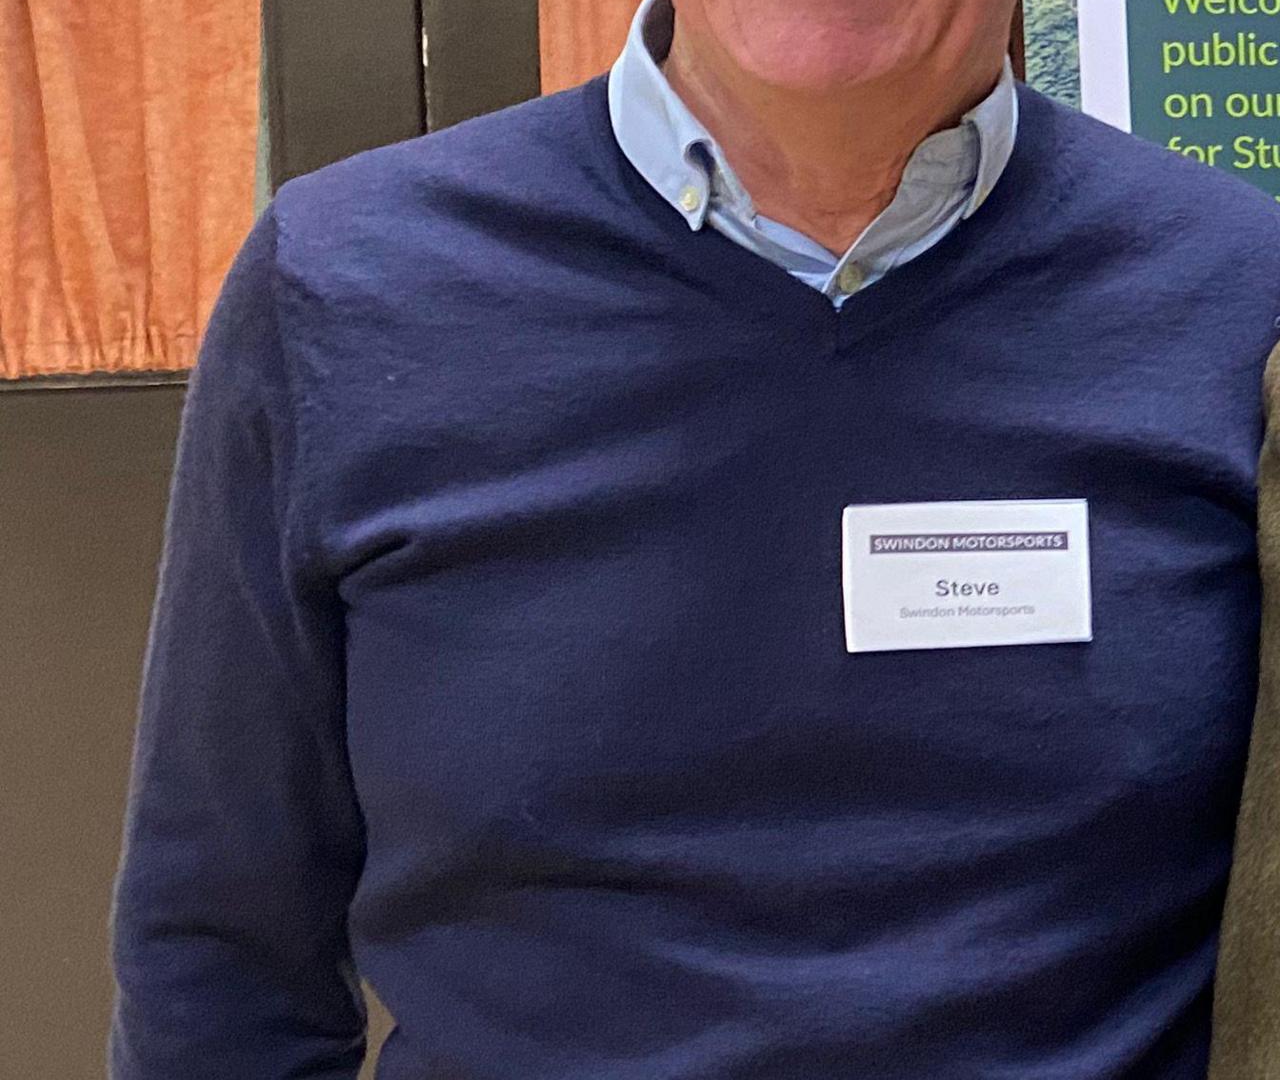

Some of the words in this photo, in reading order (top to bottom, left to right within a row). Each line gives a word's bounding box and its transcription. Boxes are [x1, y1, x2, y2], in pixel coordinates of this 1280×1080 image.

[1162, 32, 1279, 73] public
[1164, 91, 1213, 119] on
[874, 536, 950, 551] SWINDON
[953, 534, 1063, 550] MOTORSPORTS
[935, 579, 1000, 597] Steve
[900, 606, 955, 618] Swindon
[958, 605, 1035, 618] Motorsports
